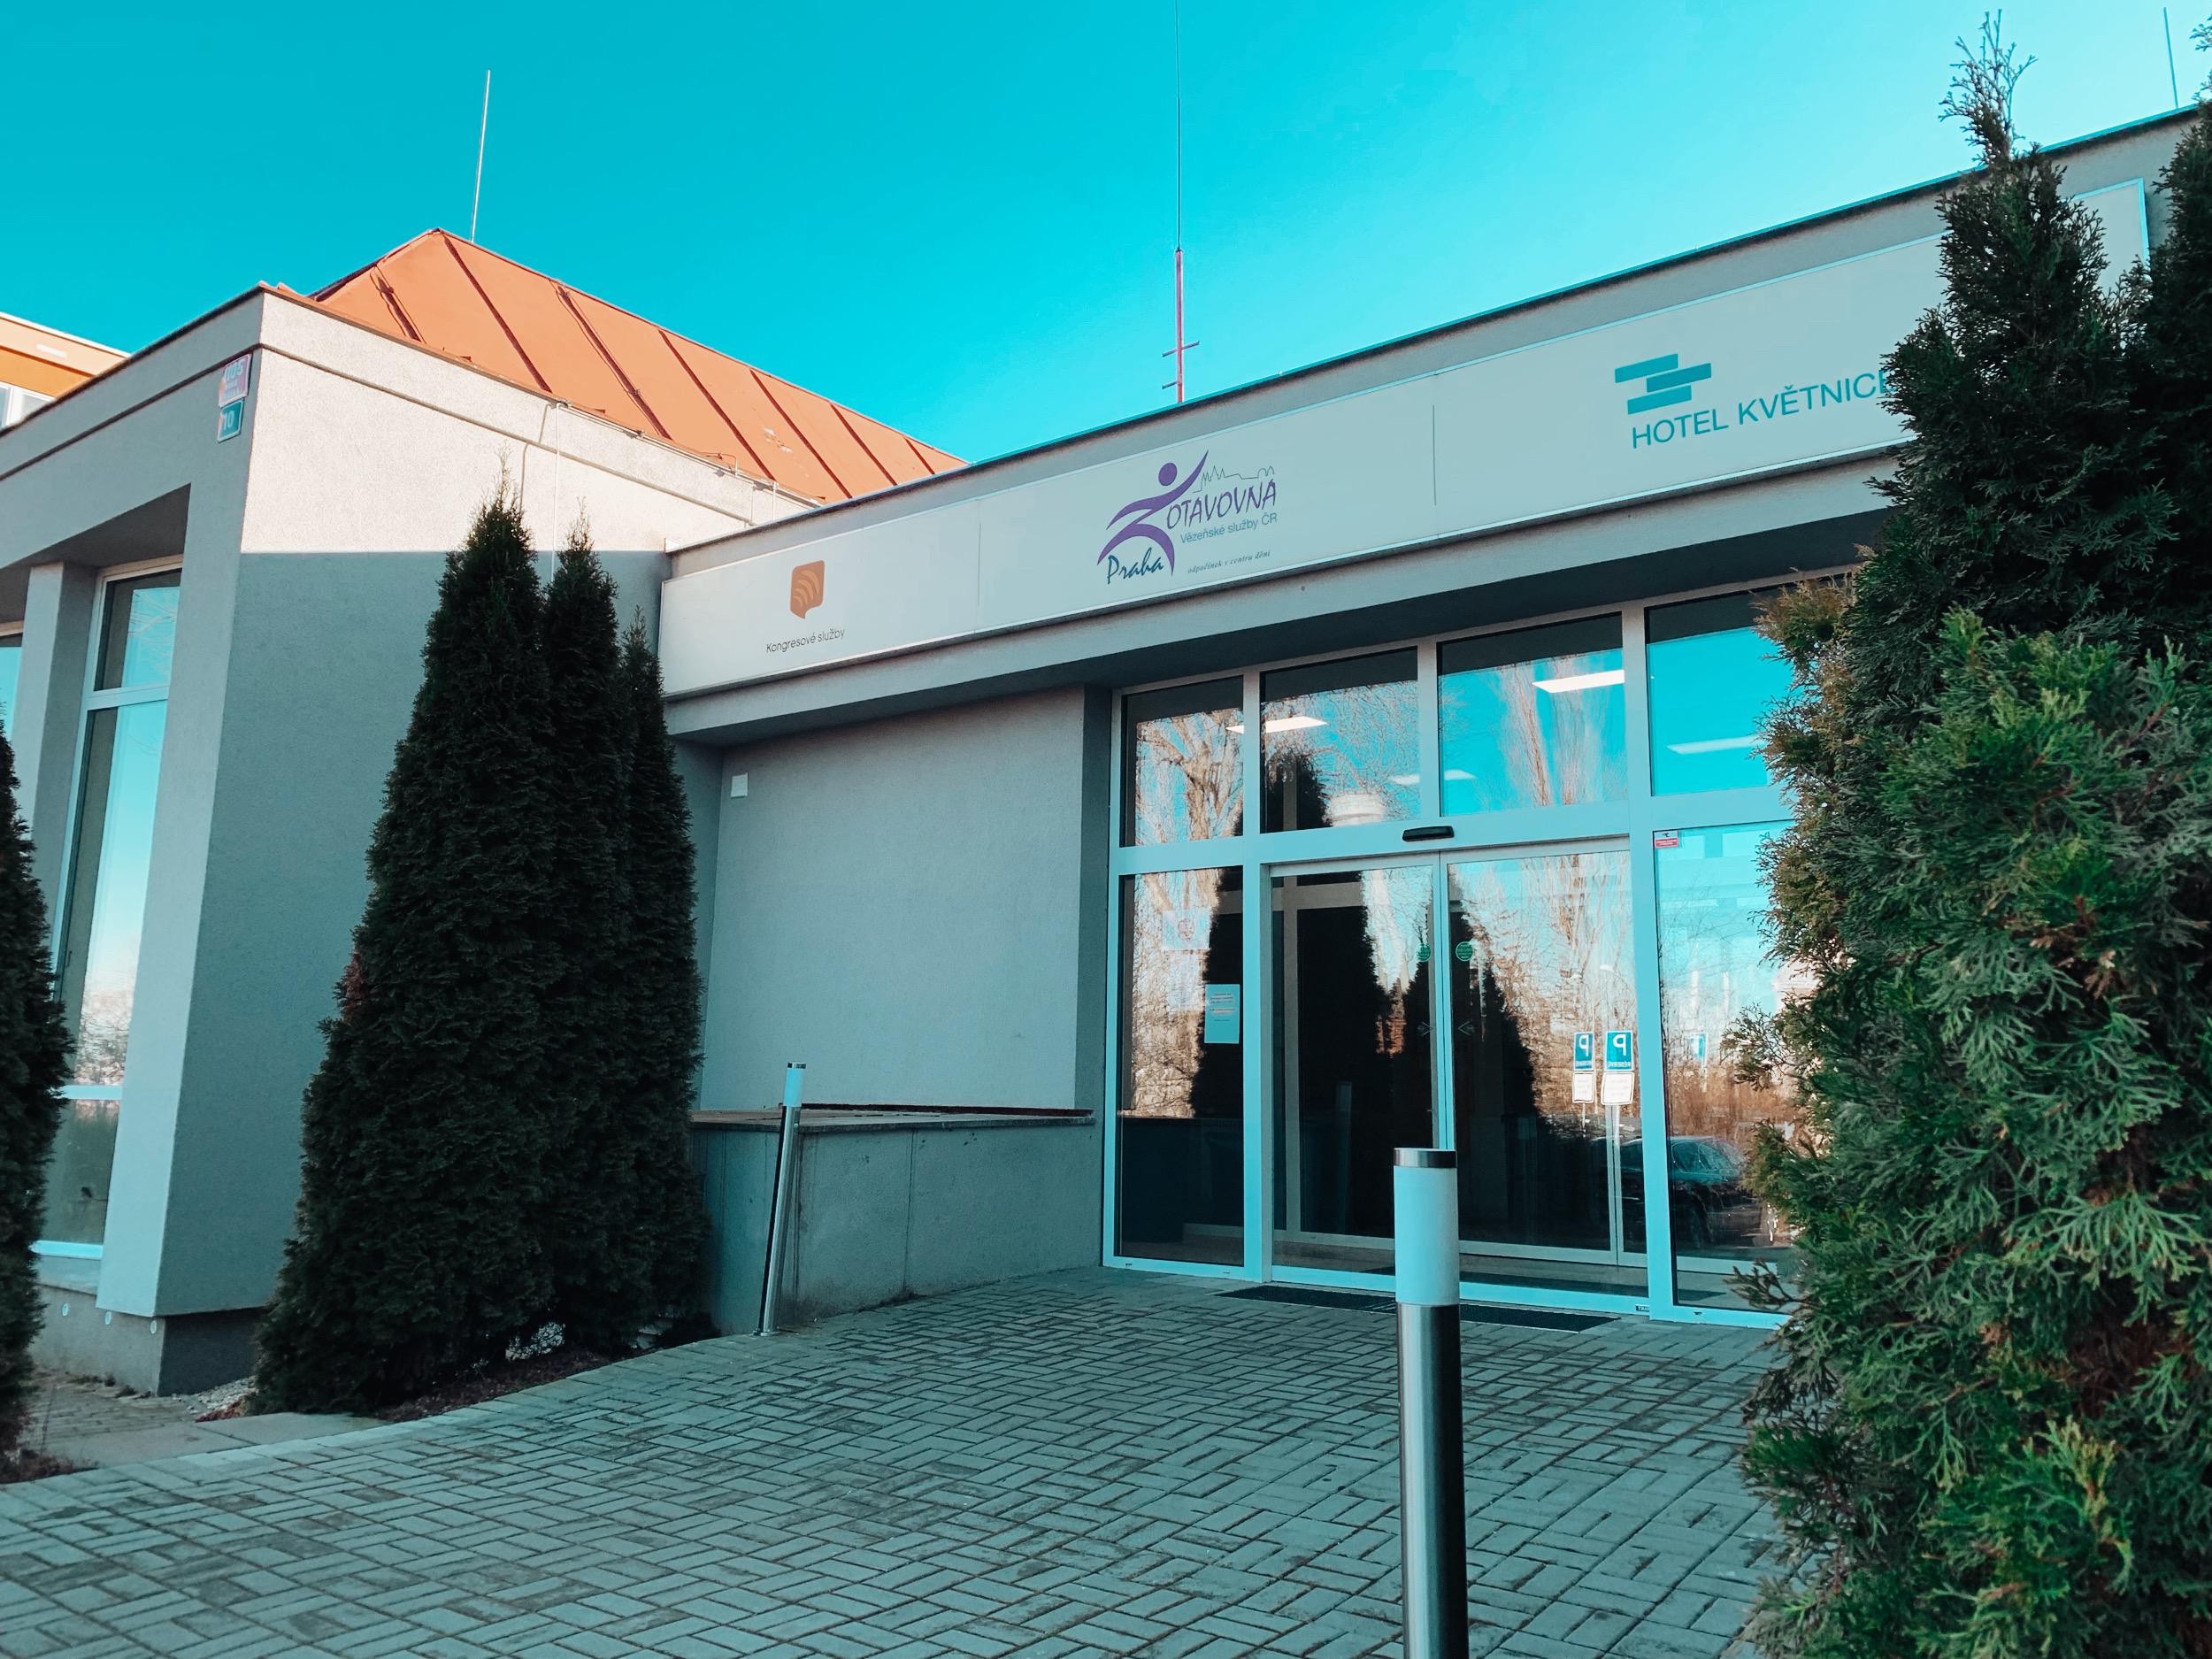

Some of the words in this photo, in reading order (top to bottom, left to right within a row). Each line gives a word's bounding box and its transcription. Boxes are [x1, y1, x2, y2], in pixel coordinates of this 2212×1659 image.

[1632, 408, 1729, 449] HOTEL
[1227, 518, 1259, 533] služby
[1261, 511, 1278, 526] ČR
[1106, 547, 1164, 585] Praha
[766, 633, 817, 653] Kongresové
[818, 627, 846, 642] služby
